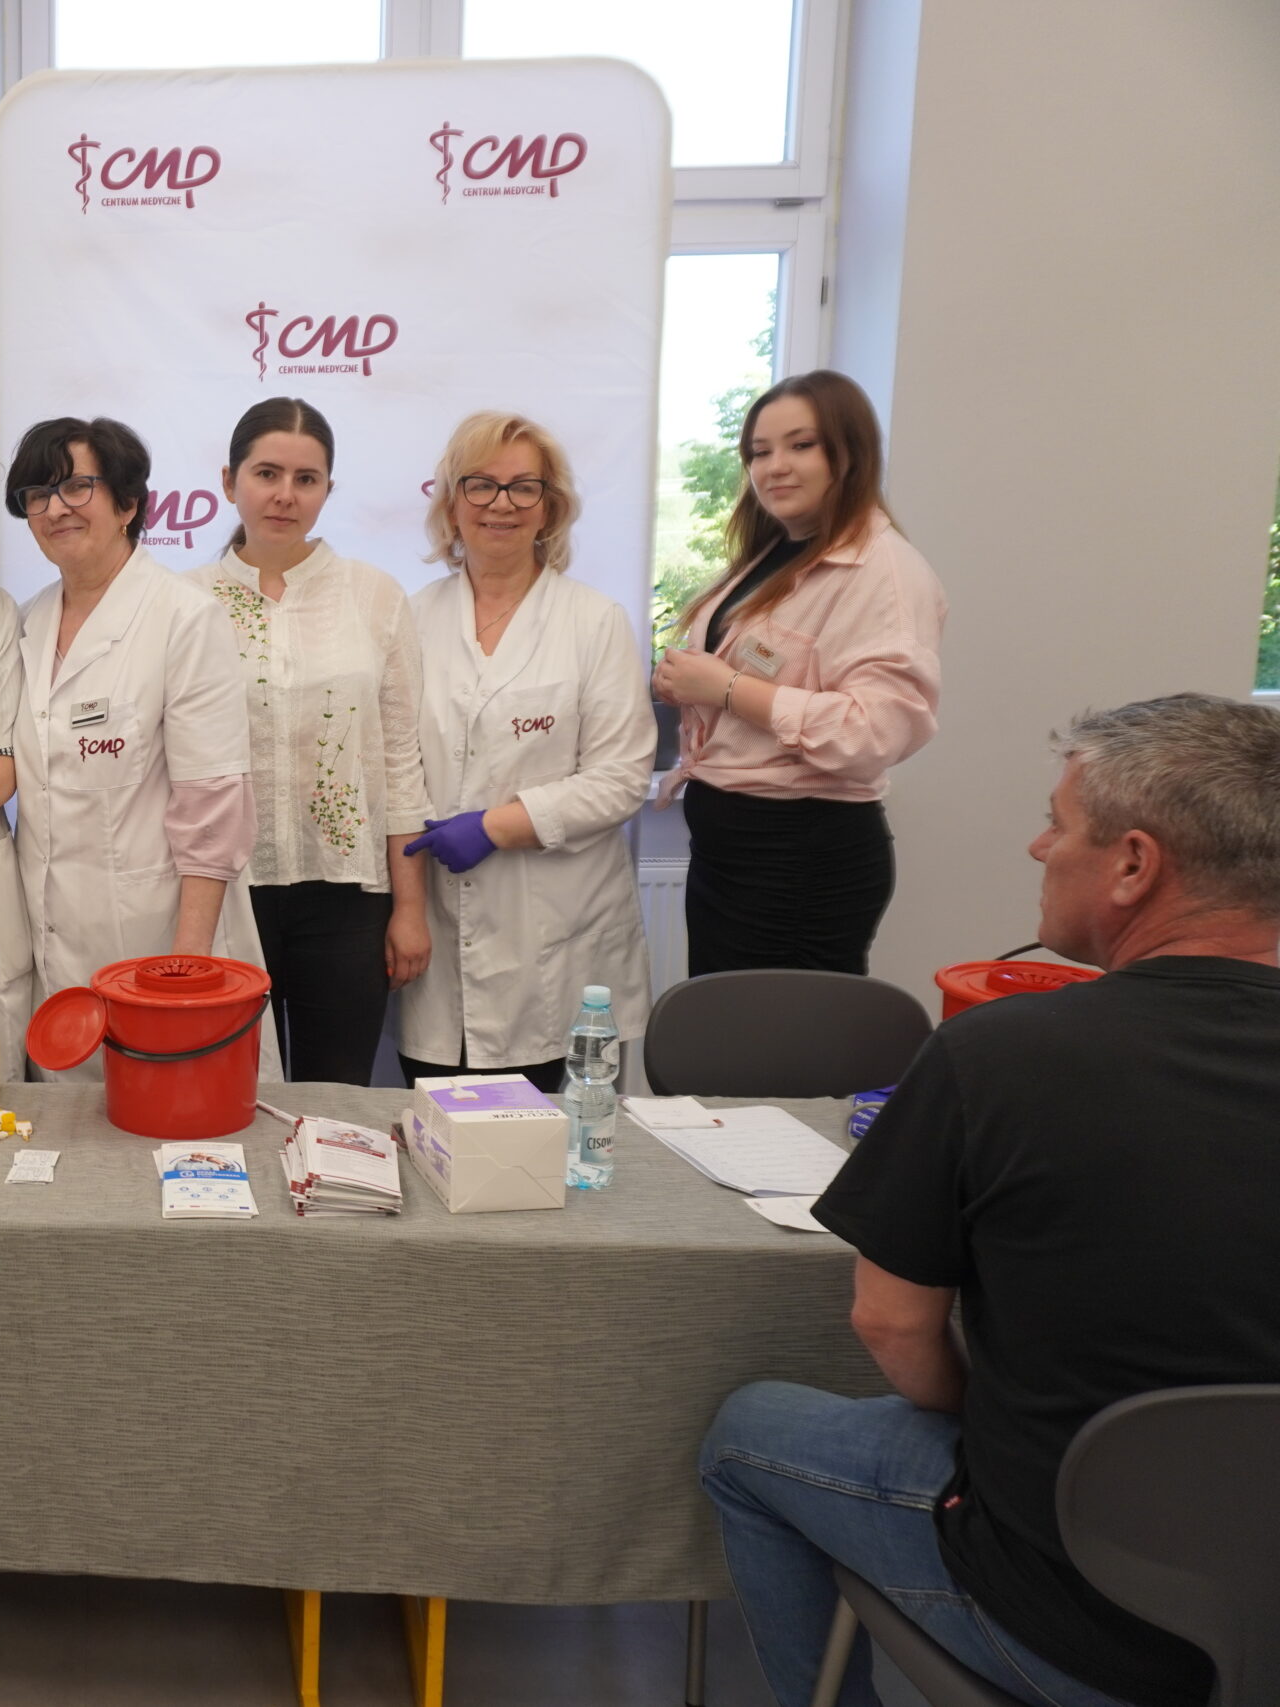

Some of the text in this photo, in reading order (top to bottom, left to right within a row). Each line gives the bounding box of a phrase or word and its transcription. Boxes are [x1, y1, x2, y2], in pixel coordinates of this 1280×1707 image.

[462, 132, 588, 198] CMP
[100, 145, 222, 209] CMP
[463, 185, 545, 197] CENTRUM MEDYCZNE
[101, 196, 182, 207] CENTRUM MEDYCZNE
[278, 313, 399, 377] CMP
[278, 364, 359, 375] CENTRUM MEDYCZNE
[144, 489, 219, 549] MP
[141, 537, 180, 546] MEDYCZNE
[522, 715, 555, 735] CMP
[87, 738, 125, 759] CMP
[586, 1136, 615, 1150] CISOW
